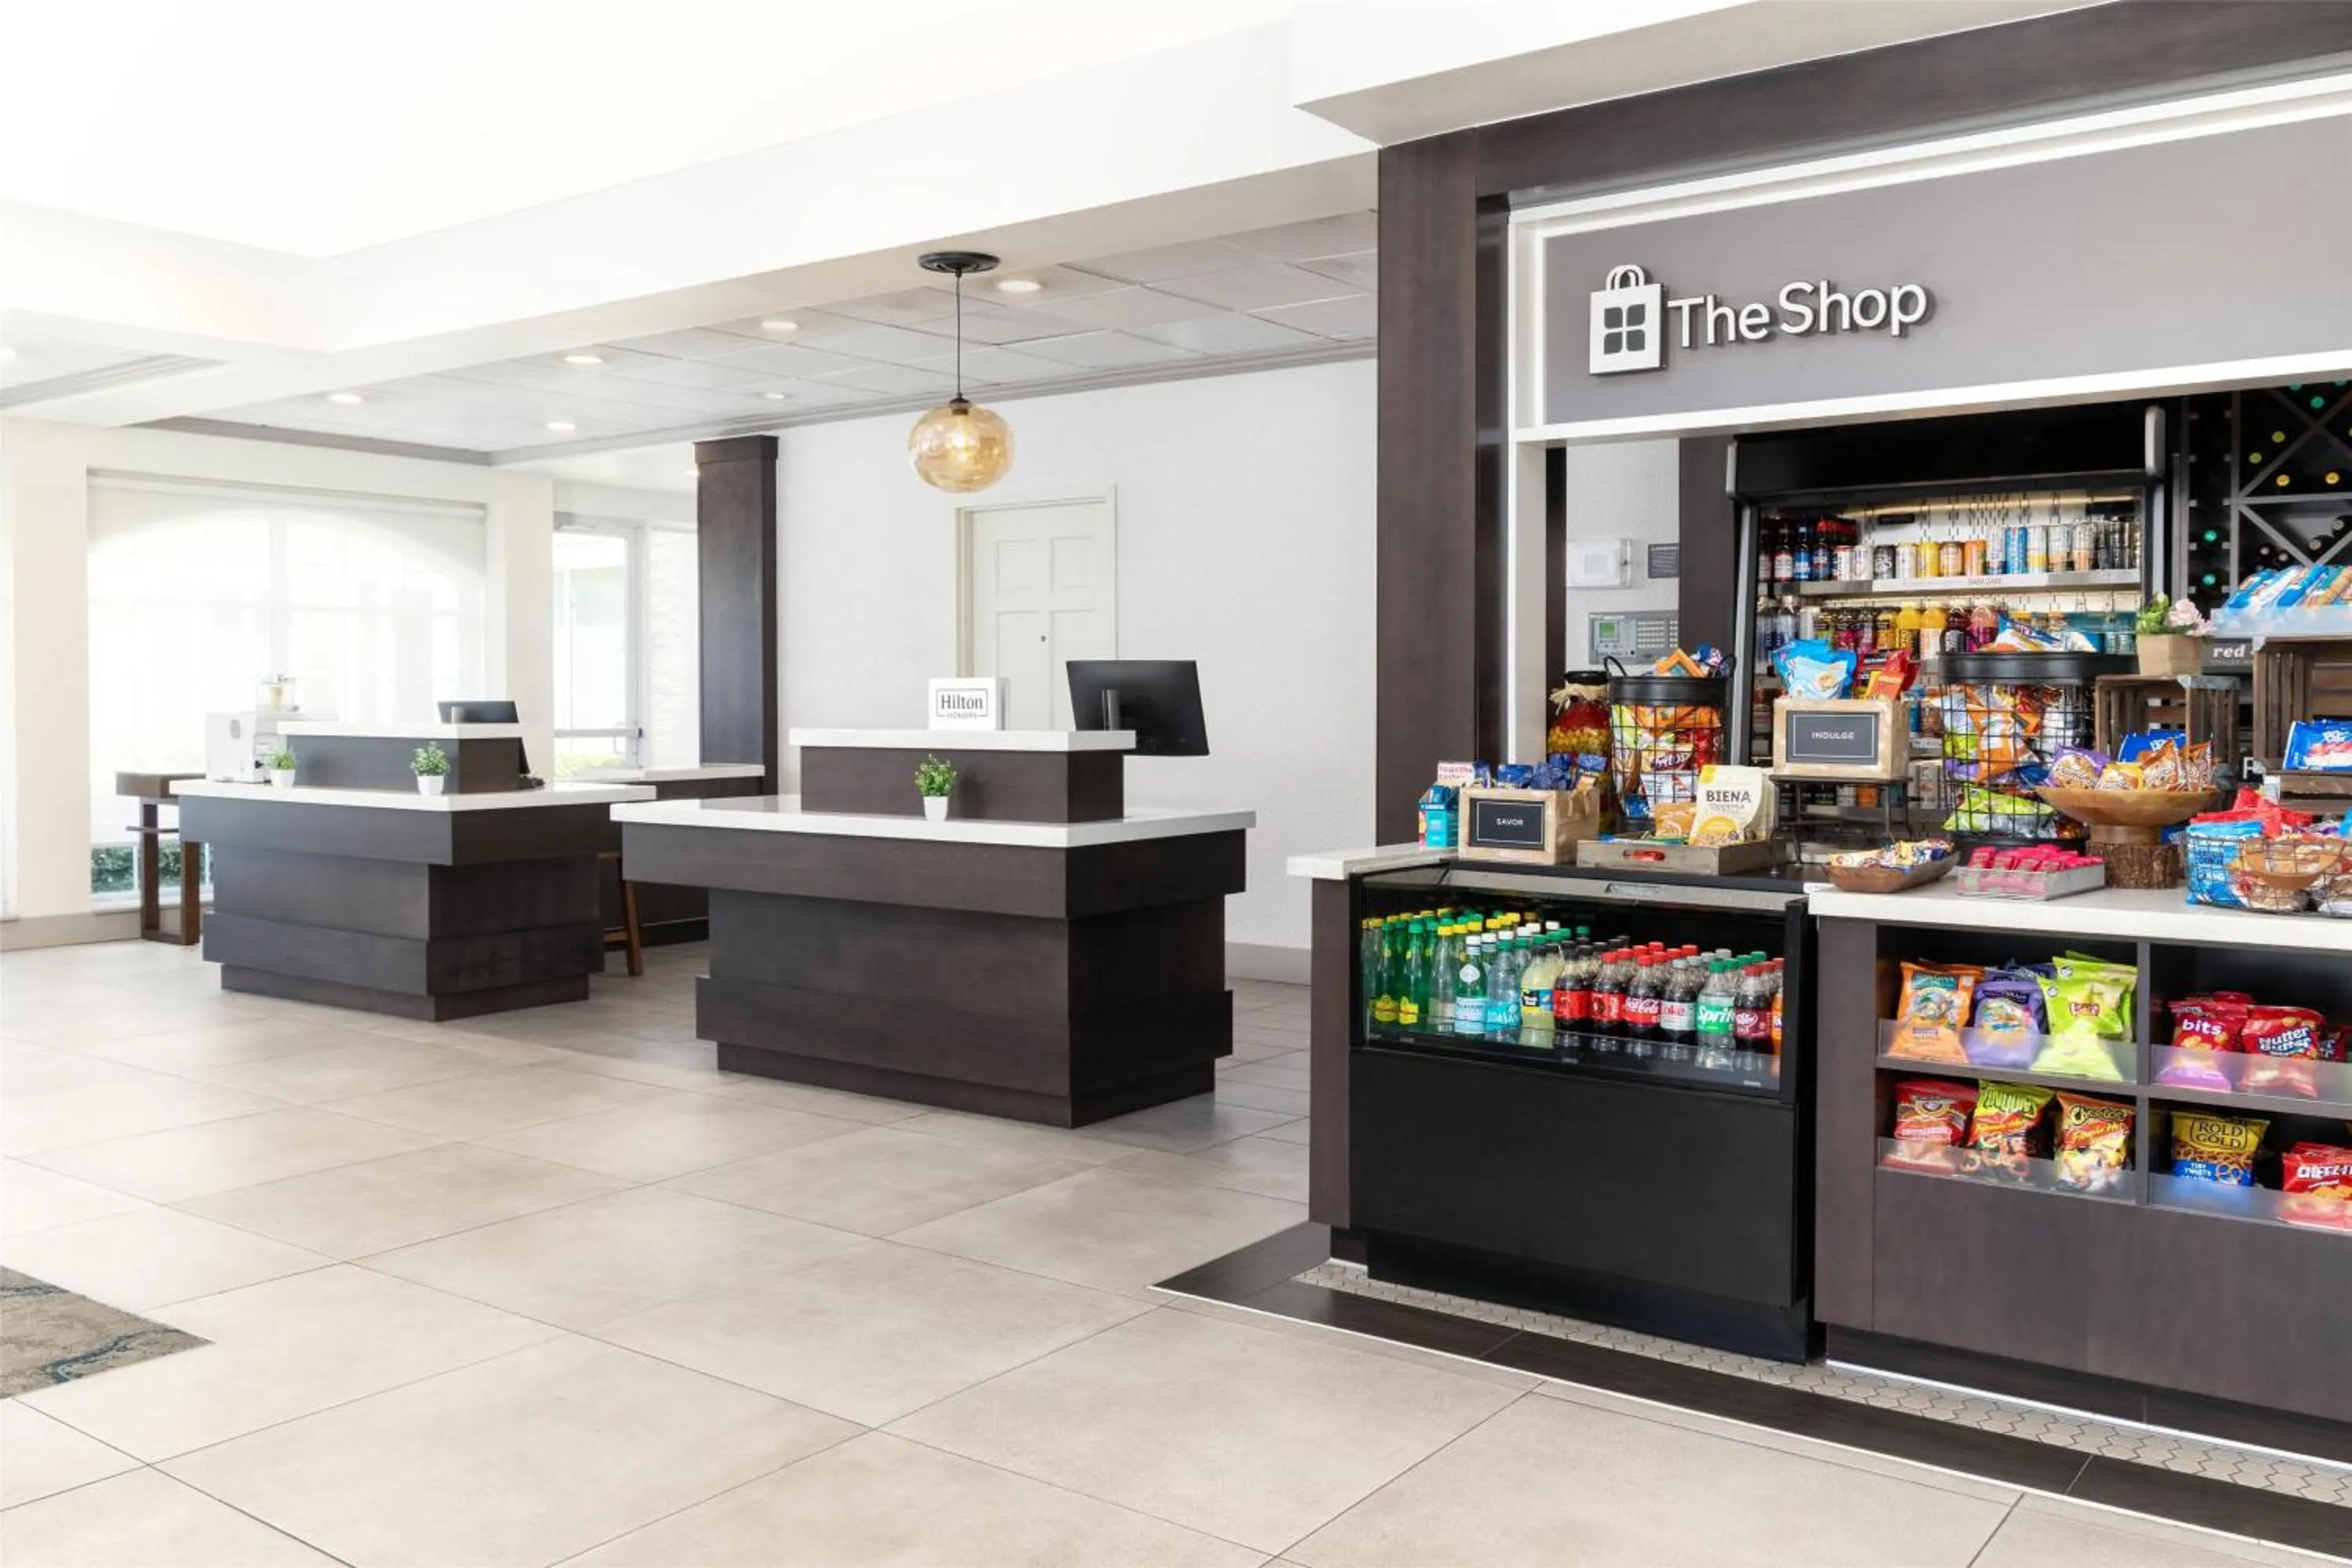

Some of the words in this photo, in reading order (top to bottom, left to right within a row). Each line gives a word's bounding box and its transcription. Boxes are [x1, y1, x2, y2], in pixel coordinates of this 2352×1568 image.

[1668, 294, 1770, 348] The
[1778, 280, 1929, 336] Shop
[2212, 644, 2246, 658] red
[941, 694, 983, 710] Hilton
[1812, 731, 1856, 740] INDULGE
[1706, 790, 1752, 803] BIENA
[1496, 818, 1523, 826] SAVOR
[2182, 1019, 2223, 1035] bits
[2259, 1027, 2309, 1045] Nutter
[2198, 1122, 2243, 1136] ROLD
[2196, 1134, 2241, 1148] GOLD
